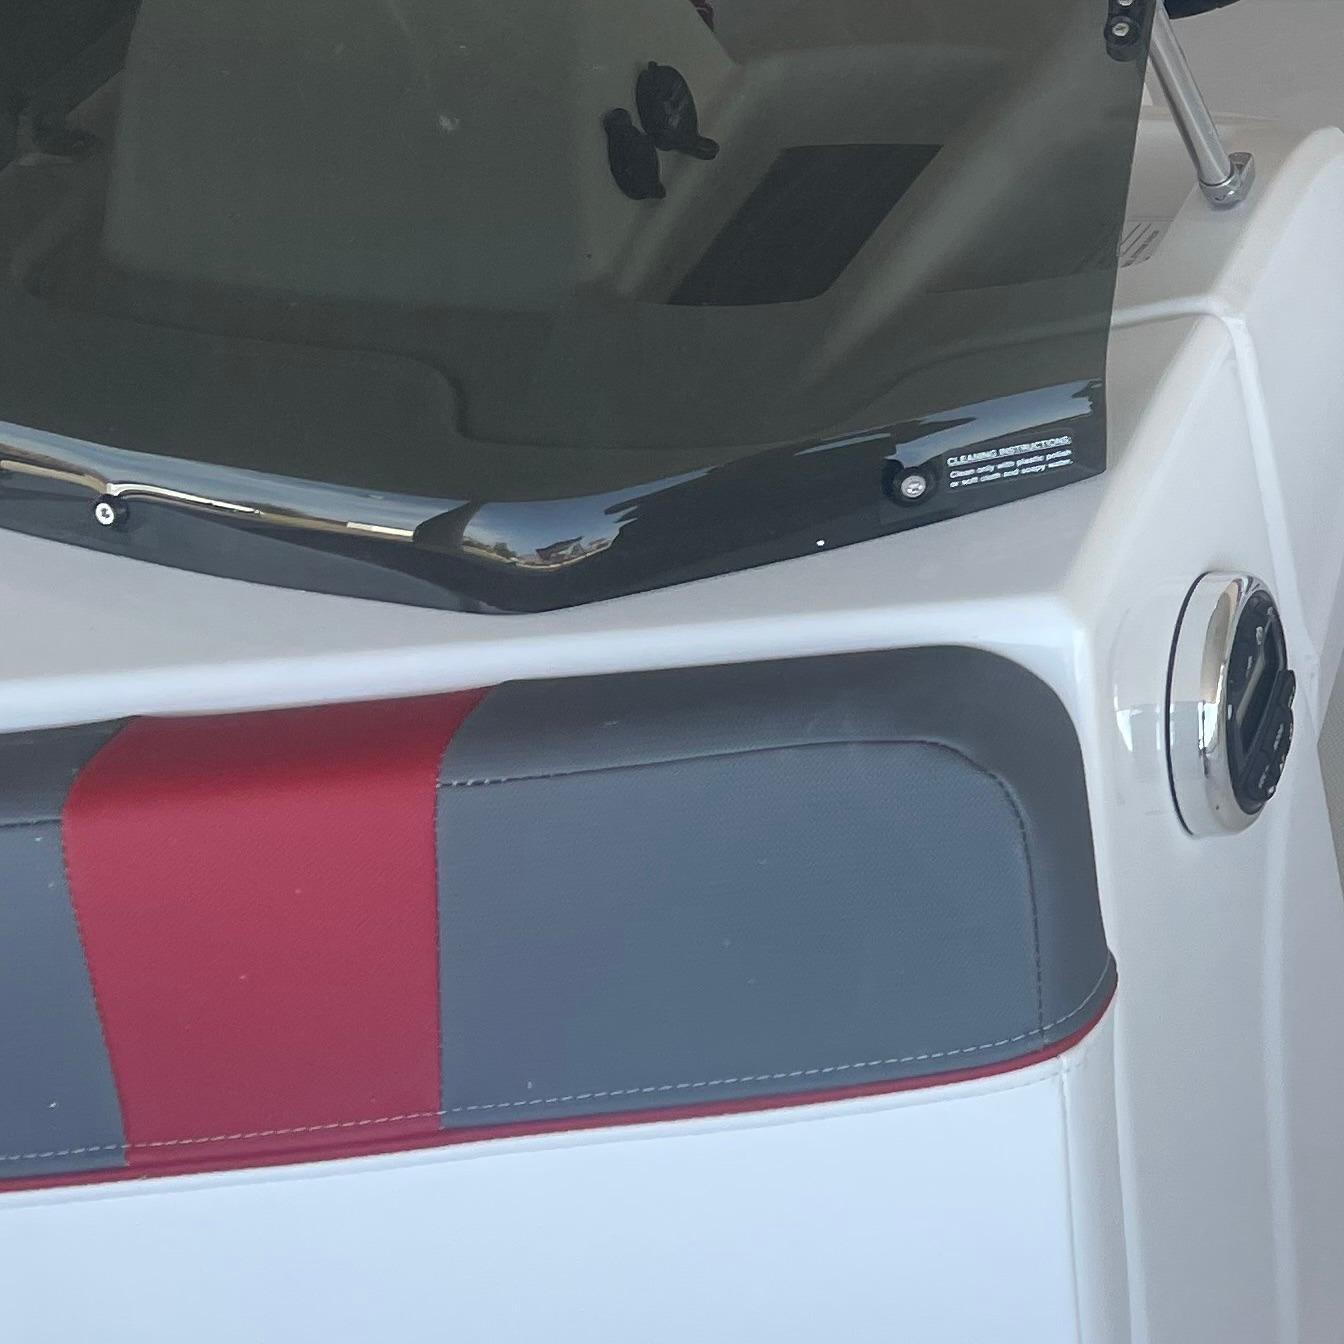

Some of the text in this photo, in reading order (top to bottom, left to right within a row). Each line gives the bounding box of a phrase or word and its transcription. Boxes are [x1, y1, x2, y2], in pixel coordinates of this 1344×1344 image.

[947, 449, 998, 467] CLEANING
[950, 469, 975, 479] Clean
[976, 465, 995, 474] only
[1016, 455, 1045, 467] plastic
[1046, 450, 1072, 461] polish
[1003, 468, 1020, 477] and
[1020, 465, 1046, 474] soapy
